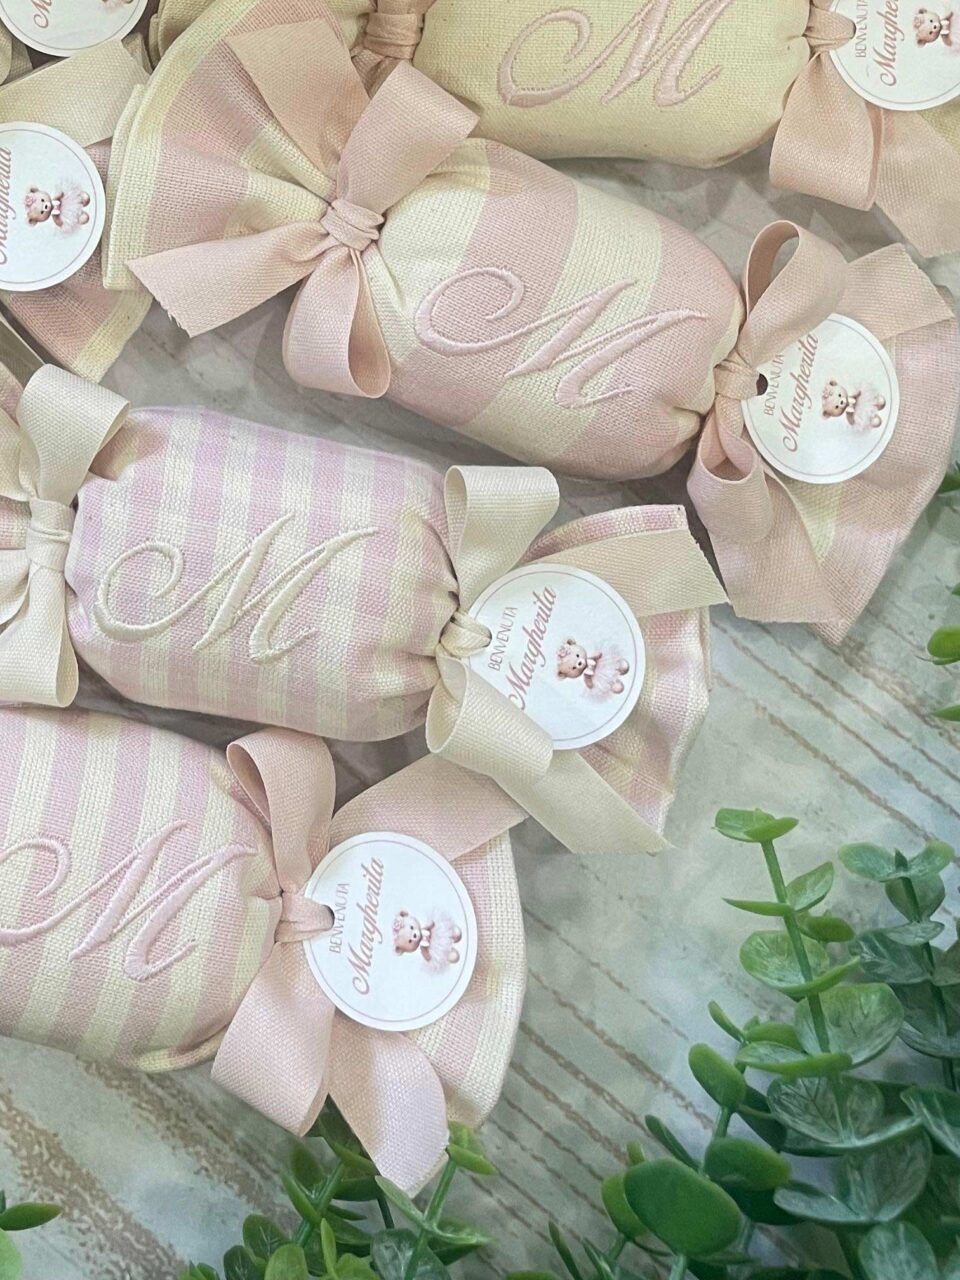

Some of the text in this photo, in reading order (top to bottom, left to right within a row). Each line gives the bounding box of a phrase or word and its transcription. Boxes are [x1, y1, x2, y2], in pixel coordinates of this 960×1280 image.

[415, 266, 707, 408] M
[762, 352, 785, 417] BENVENUTA
[779, 333, 819, 453] Margherita
[93, 513, 376, 665] M
[487, 605, 518, 672] BENVENUTA
[505, 585, 557, 711] Margherita
[328, 882, 350, 954] BENVENUTA
[346, 856, 385, 996] Margherita
